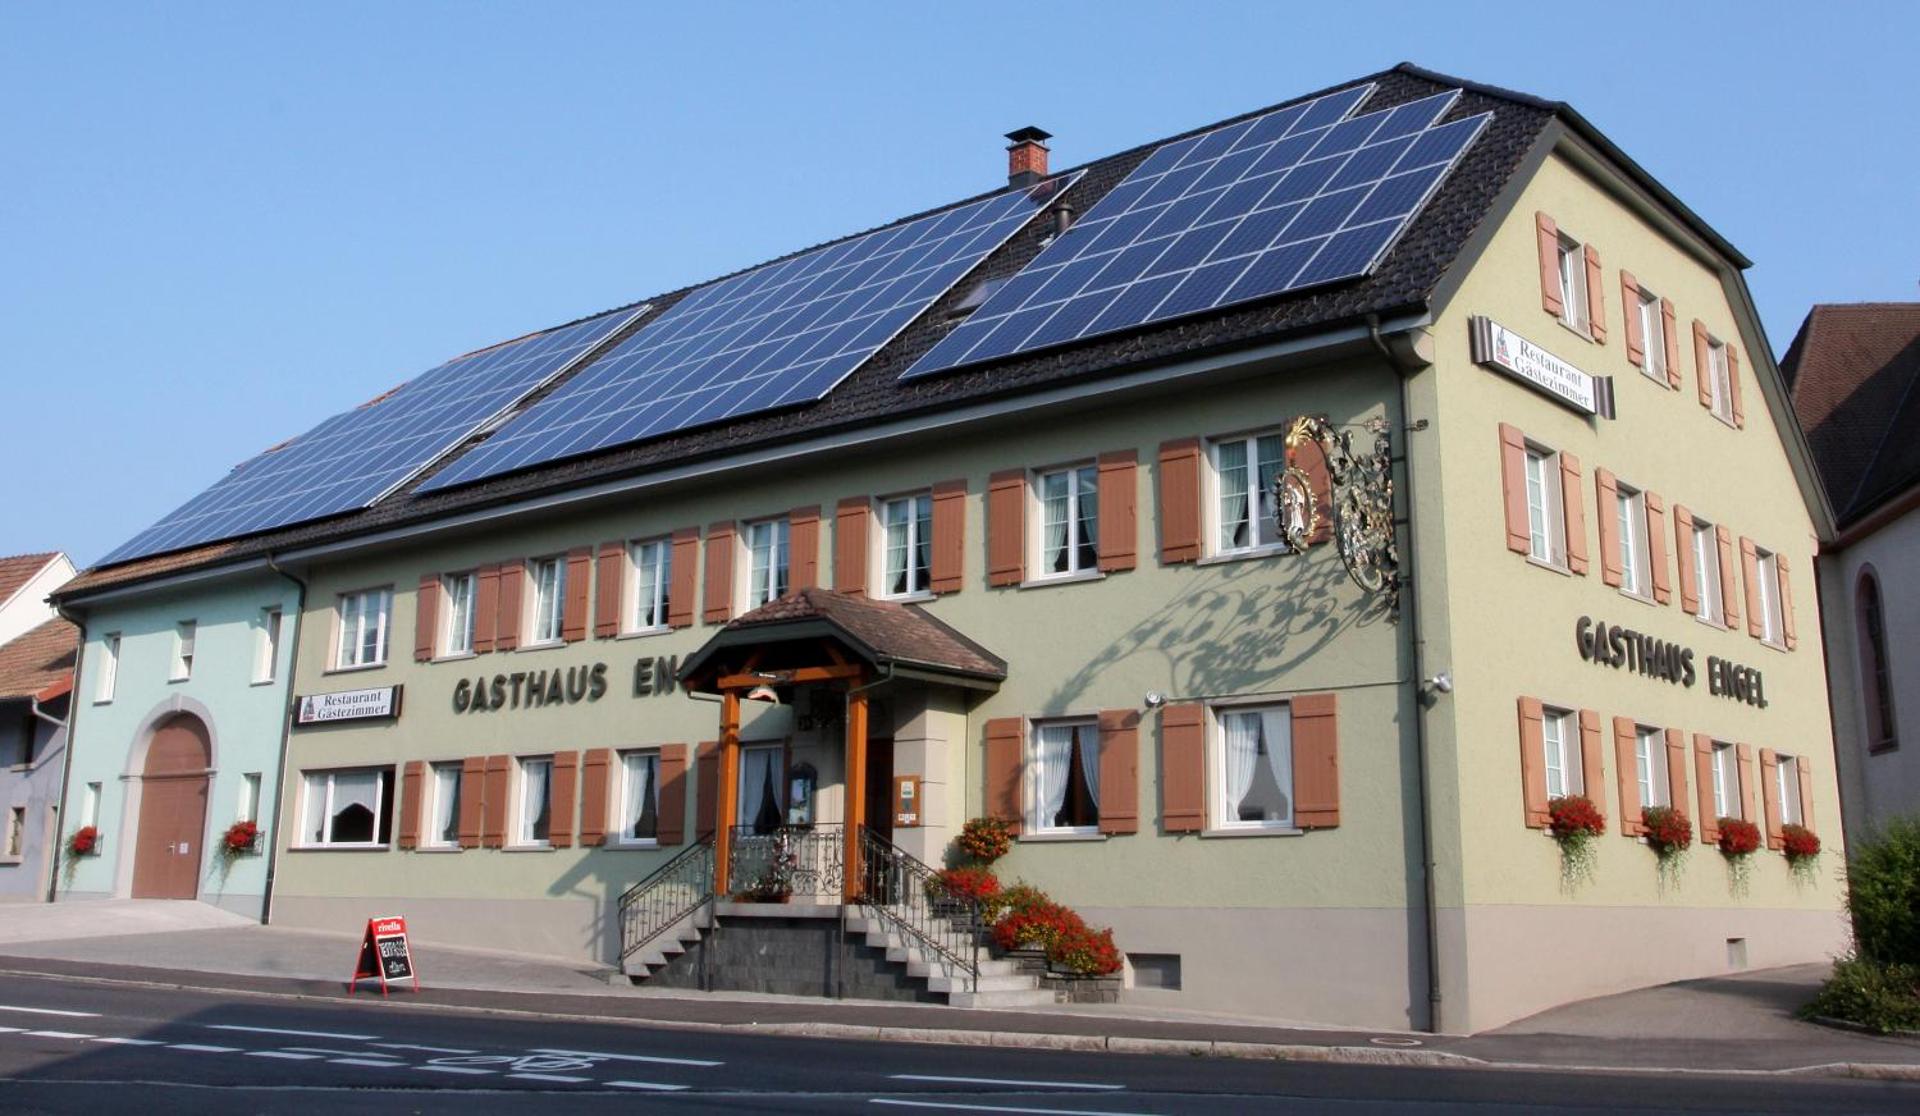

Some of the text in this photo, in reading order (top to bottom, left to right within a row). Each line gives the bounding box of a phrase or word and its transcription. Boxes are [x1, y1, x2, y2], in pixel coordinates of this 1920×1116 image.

[1514, 355, 1590, 407] Gästezimmer
[1519, 340, 1582, 387] Restaurant
[454, 652, 698, 714] GASTHAUS EN
[1576, 615, 1769, 709] GASTHAUS ENGEL
[317, 704, 387, 720] Gästezimmer
[324, 690, 382, 707] Restaurant
